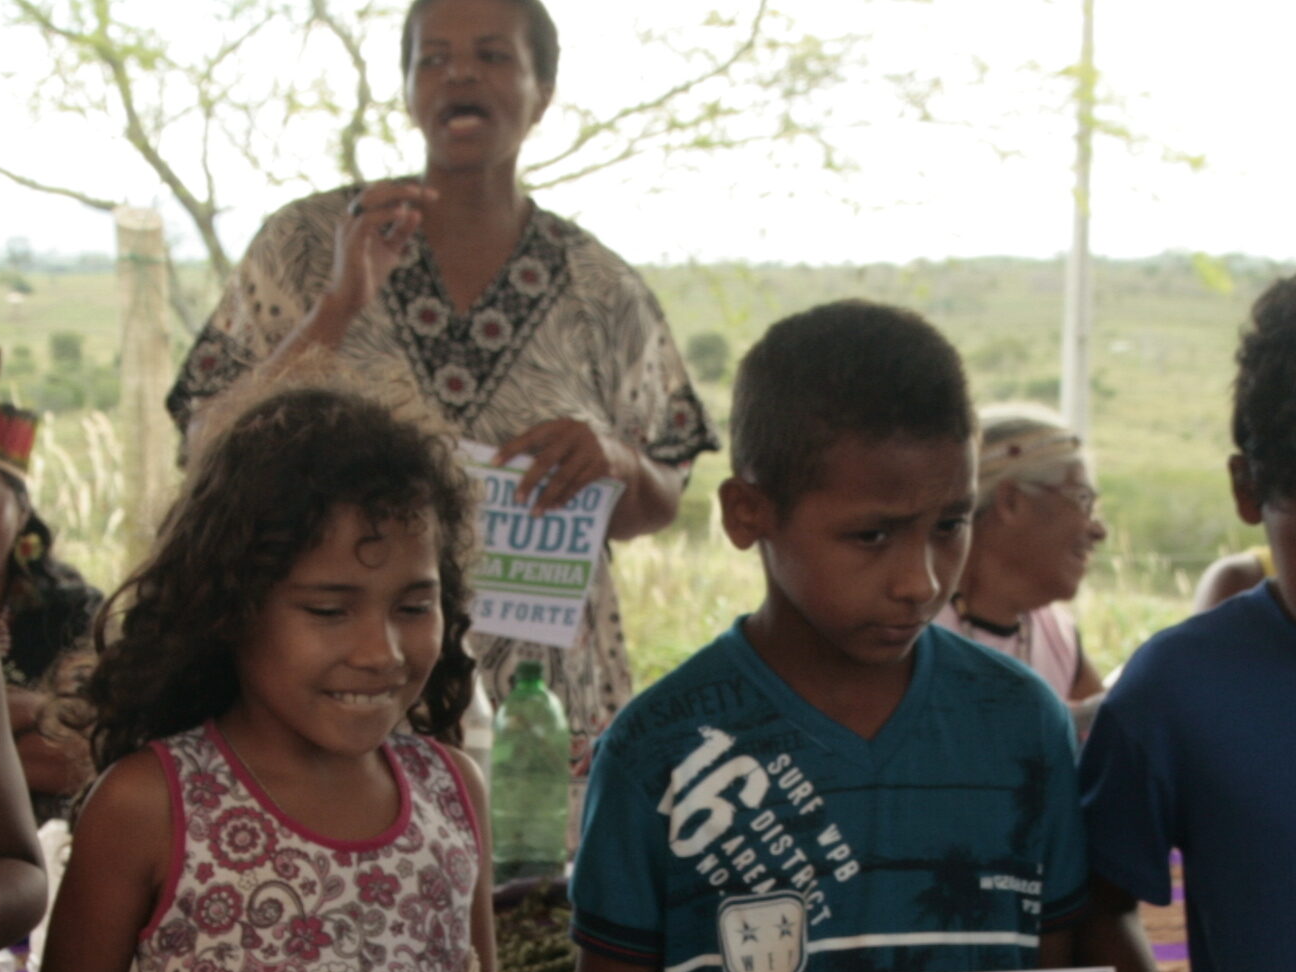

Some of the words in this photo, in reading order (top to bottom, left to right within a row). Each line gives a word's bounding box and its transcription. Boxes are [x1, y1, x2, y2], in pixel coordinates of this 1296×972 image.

[509, 559, 584, 586] PENHA
[499, 601, 578, 627] FORTE
[657, 725, 772, 859] 16
[767, 753, 825, 817] SURF
[816, 823, 863, 884] WPB
[721, 834, 777, 896] AREA
